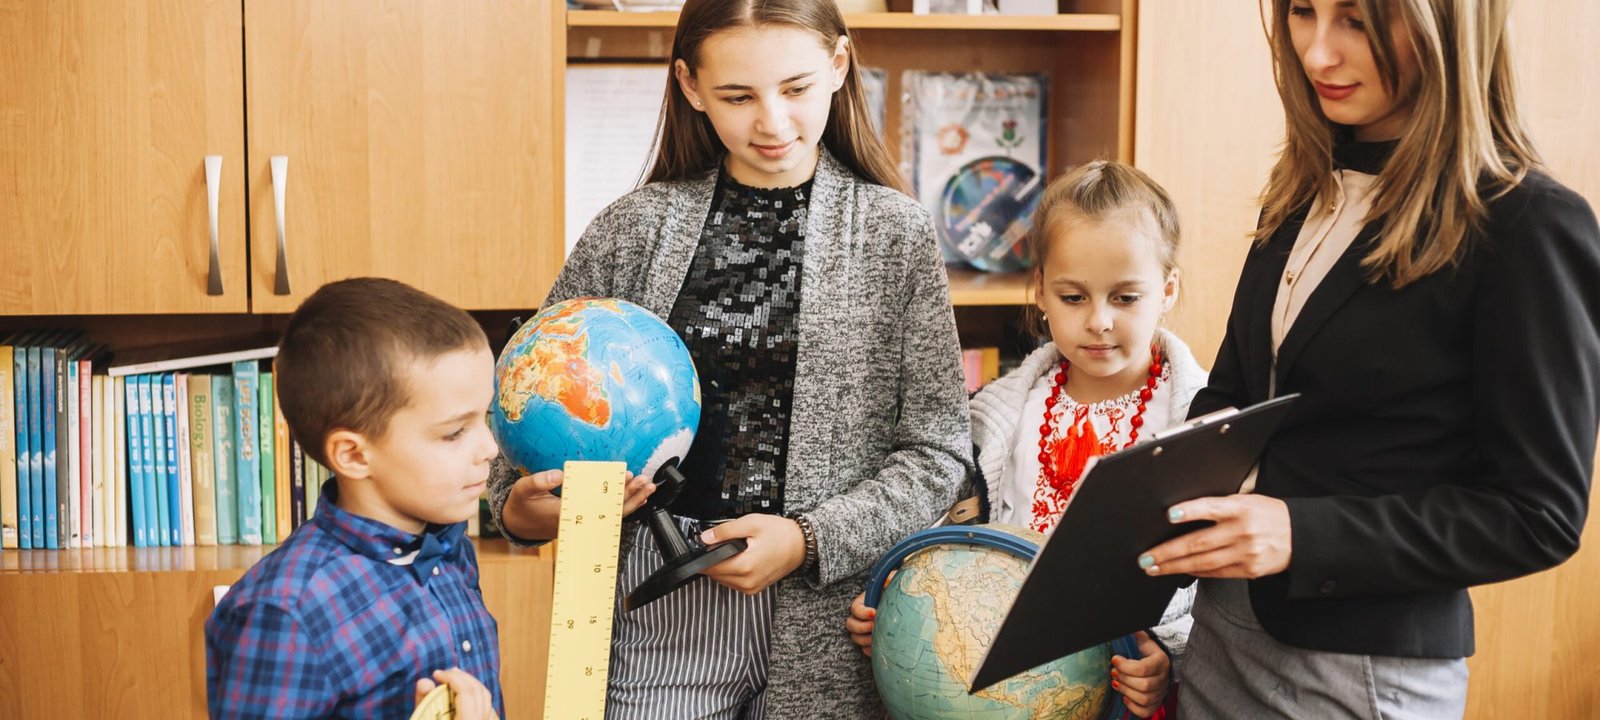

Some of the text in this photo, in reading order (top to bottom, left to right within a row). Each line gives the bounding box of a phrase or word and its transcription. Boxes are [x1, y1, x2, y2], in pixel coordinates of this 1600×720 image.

[192, 394, 207, 449] Biology
[602, 481, 608, 494] cm
[593, 564, 601, 573] 10
[567, 620, 574, 629] 60
[589, 616, 597, 624] 15
[585, 666, 592, 676] 20
